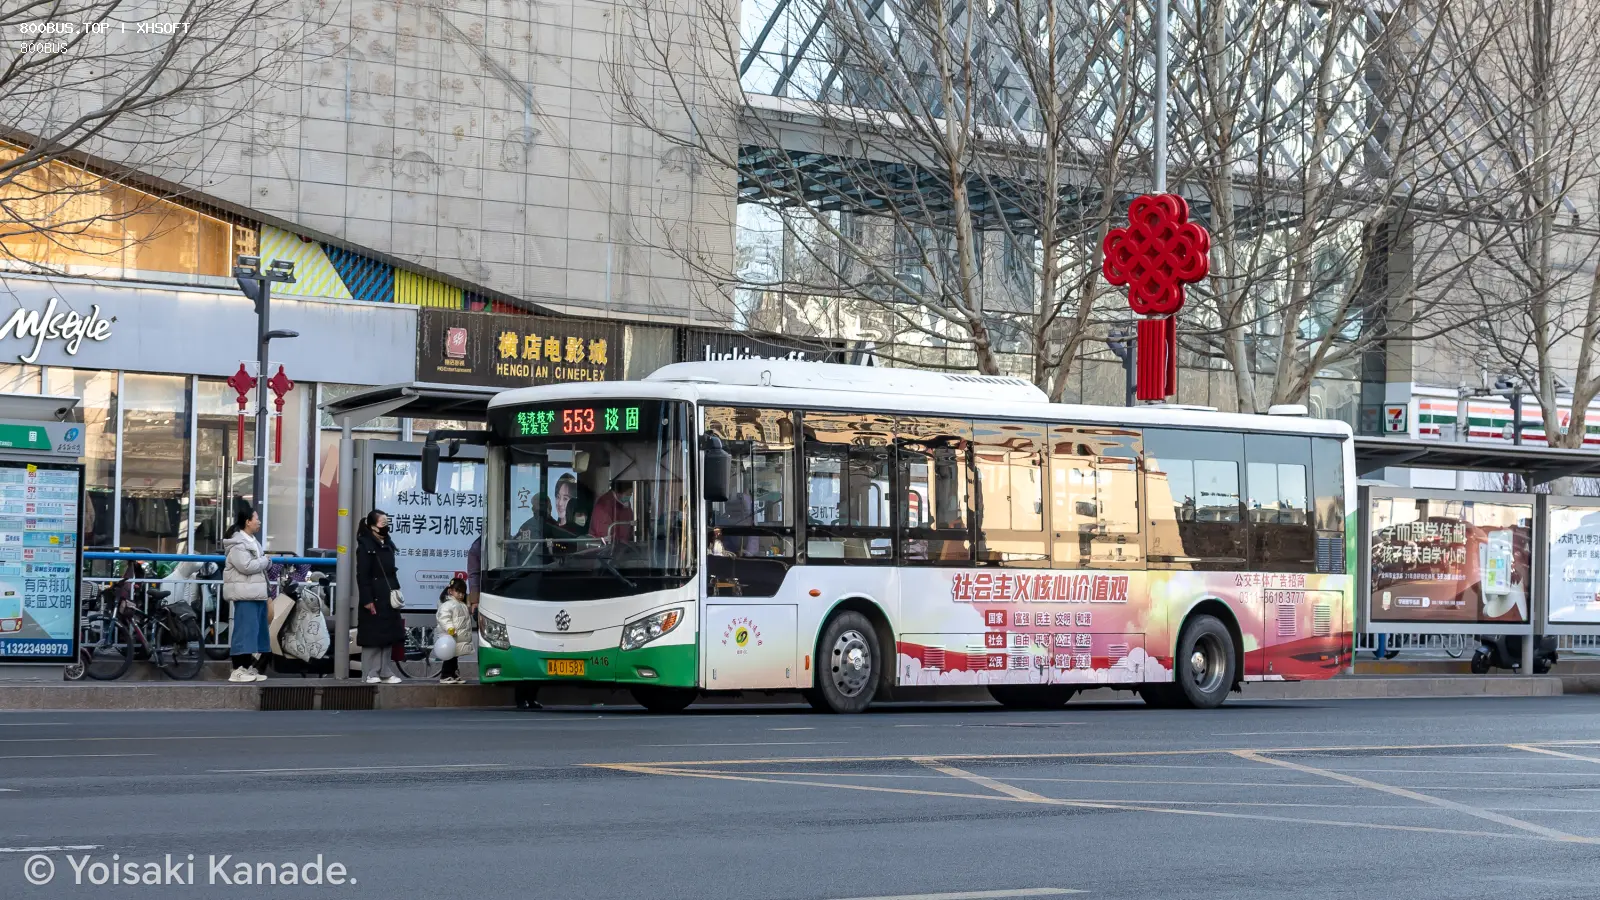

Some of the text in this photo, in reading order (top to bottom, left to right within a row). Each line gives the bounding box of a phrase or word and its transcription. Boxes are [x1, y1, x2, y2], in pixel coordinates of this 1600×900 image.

[498, 331, 608, 366] 横店电影城
[496, 363, 605, 382] HENGDIAN CINEPLEX
[517, 406, 639, 434] 经济技术 553 谈固
[521, 422, 549, 435] 开发区
[24, 578, 72, 593] 有序排队
[953, 572, 1129, 601] 社会主义核心价值观
[1235, 573, 1305, 587] 公交车体广告招商
[24, 594, 72, 609] 彰显文明
[1285, 591, 1306, 604] 3777
[988, 611, 1092, 625] 国家 富强 民主 文明 和谐
[988, 633, 1092, 647] 社会 自由 平等 公正 法治
[6, 643, 69, 654] 13223499979
[590, 656, 609, 667] 1416
[988, 655, 1004, 668] 公民
[1055, 654, 1071, 668] 诚信
[1075, 654, 1092, 668] 友善
